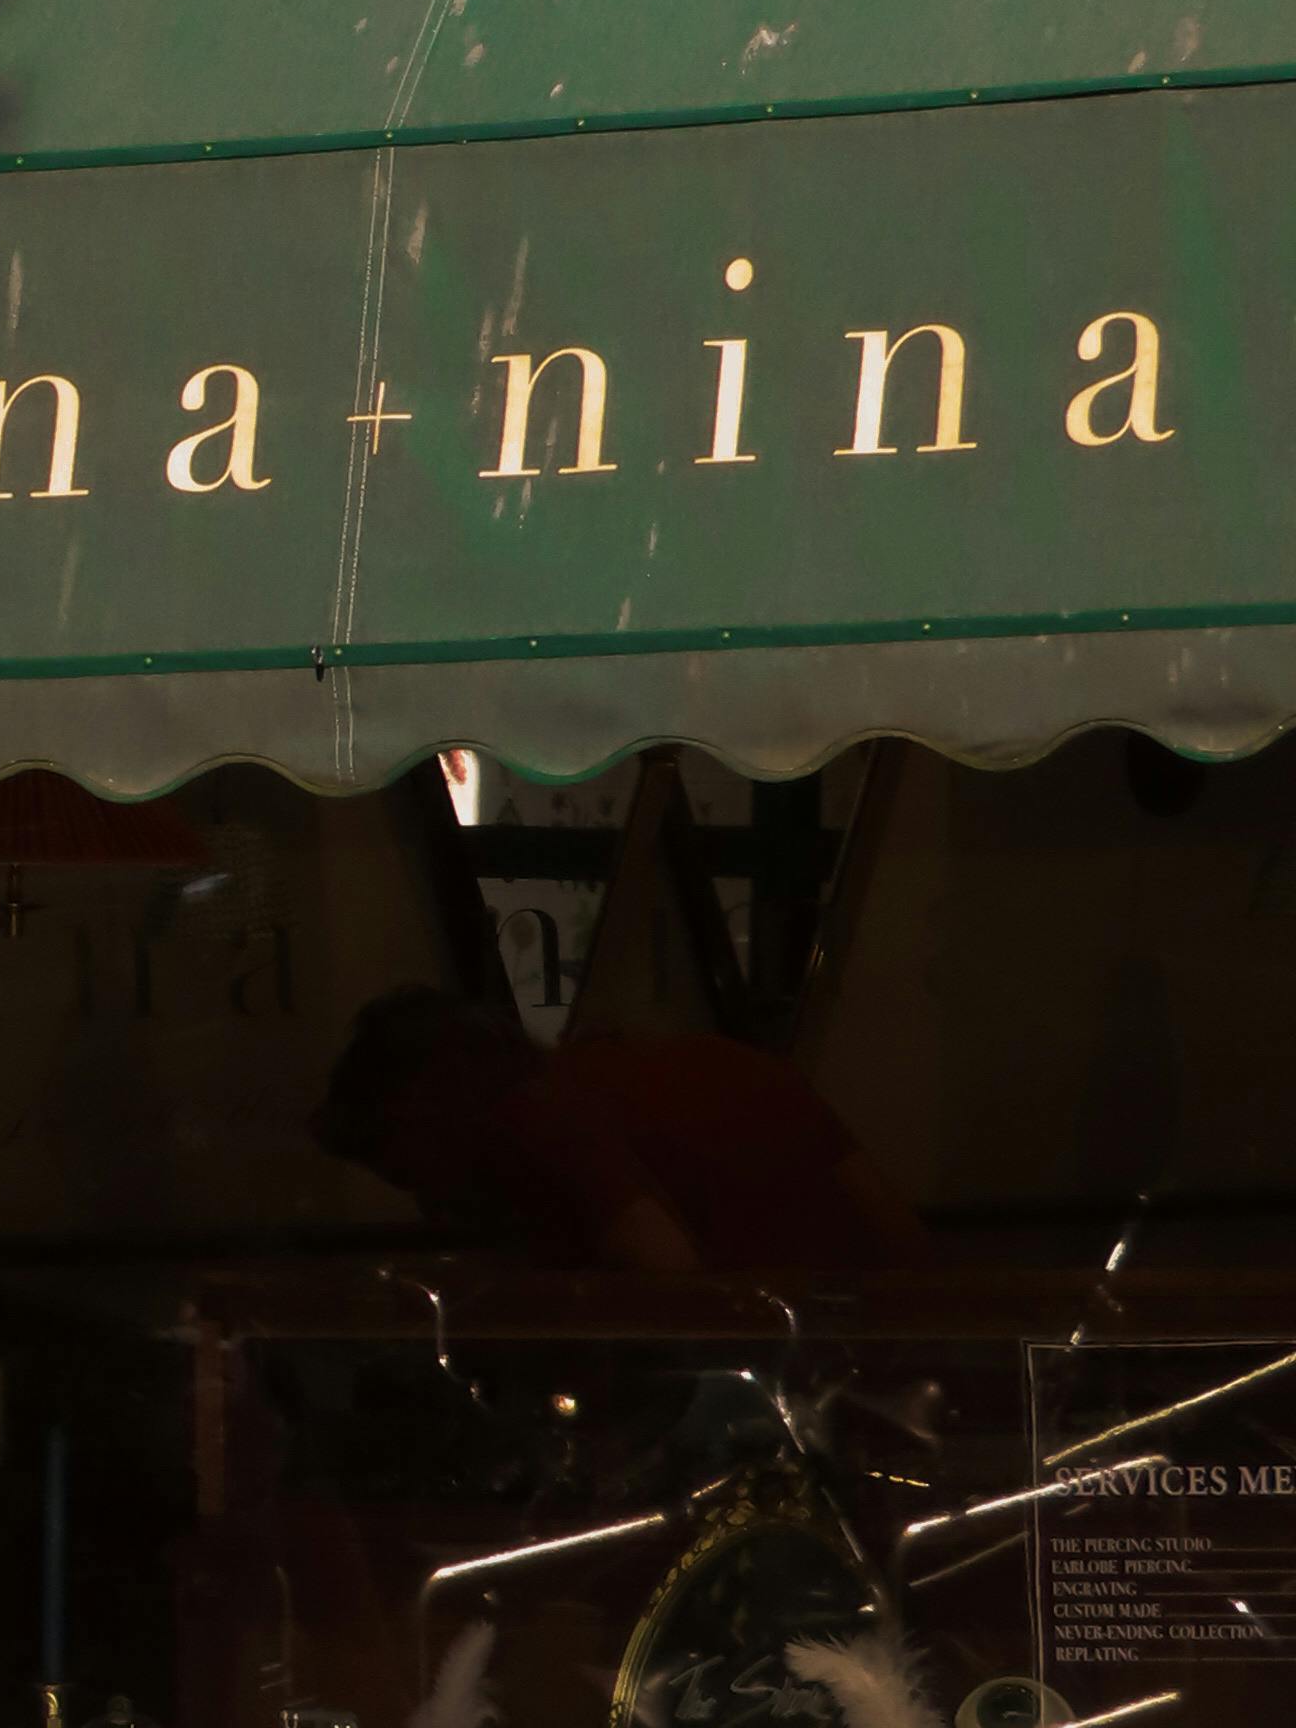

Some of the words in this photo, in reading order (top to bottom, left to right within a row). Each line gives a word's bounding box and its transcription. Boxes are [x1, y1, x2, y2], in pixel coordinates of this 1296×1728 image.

[1054, 1465, 1228, 1497] SERVICES
[1237, 1465, 1296, 1496] ME
[1050, 1536, 1082, 1553] THE
[1084, 1536, 1153, 1553] PIERCING
[1155, 1536, 1212, 1553] STUDIO
[1051, 1558, 1118, 1574] EARLOBE
[1124, 1558, 1192, 1574] PIERCING
[1053, 1580, 1137, 1596] ENGRAVING
[1053, 1602, 1114, 1618] CUSTOM
[1118, 1602, 1160, 1618] MADE
[1054, 1623, 1163, 1639] NEVER-ENDING
[1168, 1623, 1264, 1639] COLLECTION
[1056, 1645, 1139, 1661] REPLATING
